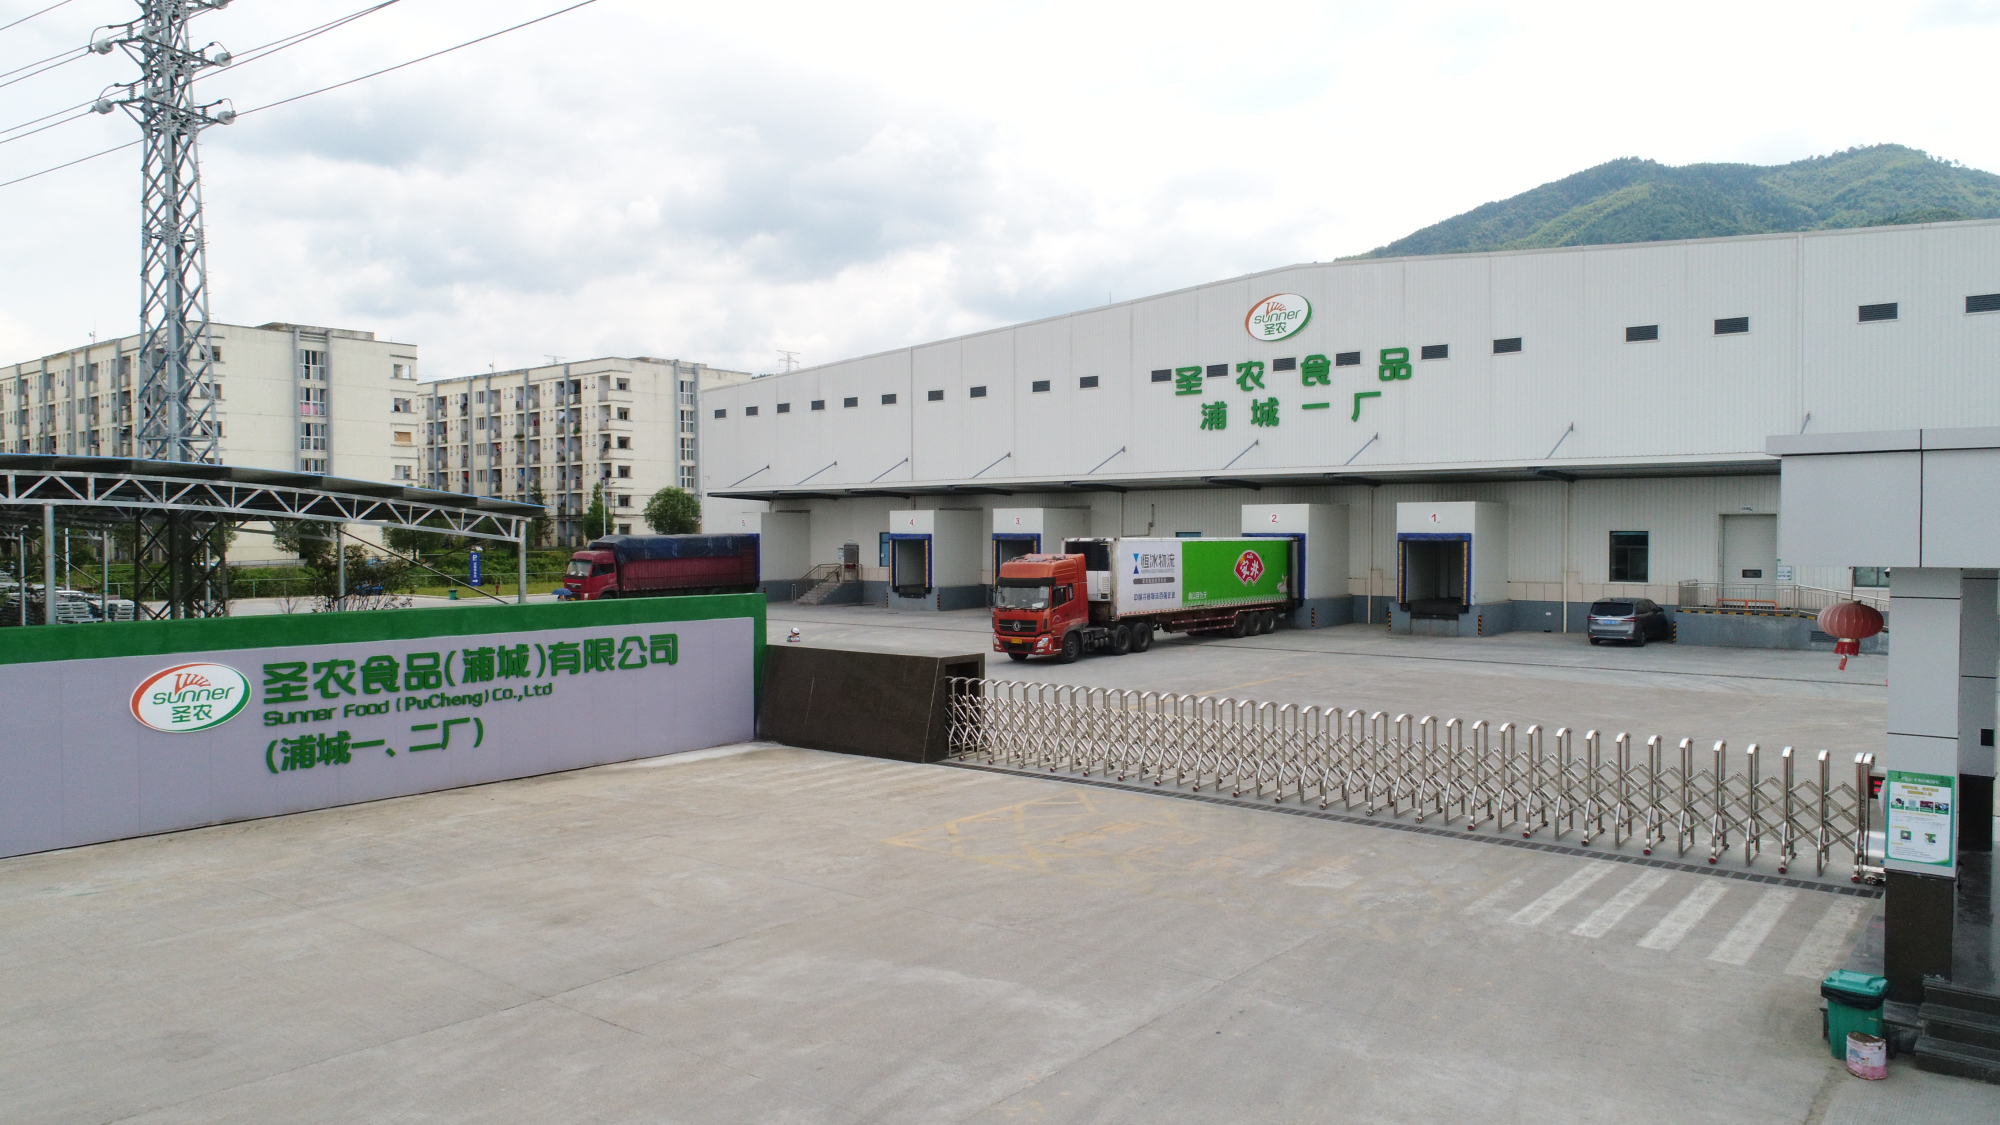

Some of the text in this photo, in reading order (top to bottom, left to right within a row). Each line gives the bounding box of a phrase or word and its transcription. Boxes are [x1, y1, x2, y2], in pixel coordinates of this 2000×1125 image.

[1254, 309, 1301, 324] sunner
[1264, 321, 1287, 335] 圣农
[1175, 347, 1412, 396] 圣农食品
[1200, 390, 1382, 431] 浦城一厂
[1271, 513, 1278, 523] 2
[152, 686, 235, 705] sunner
[171, 704, 212, 723] 圣农
[263, 707, 338, 727] Sunner
[344, 700, 390, 718] Food
